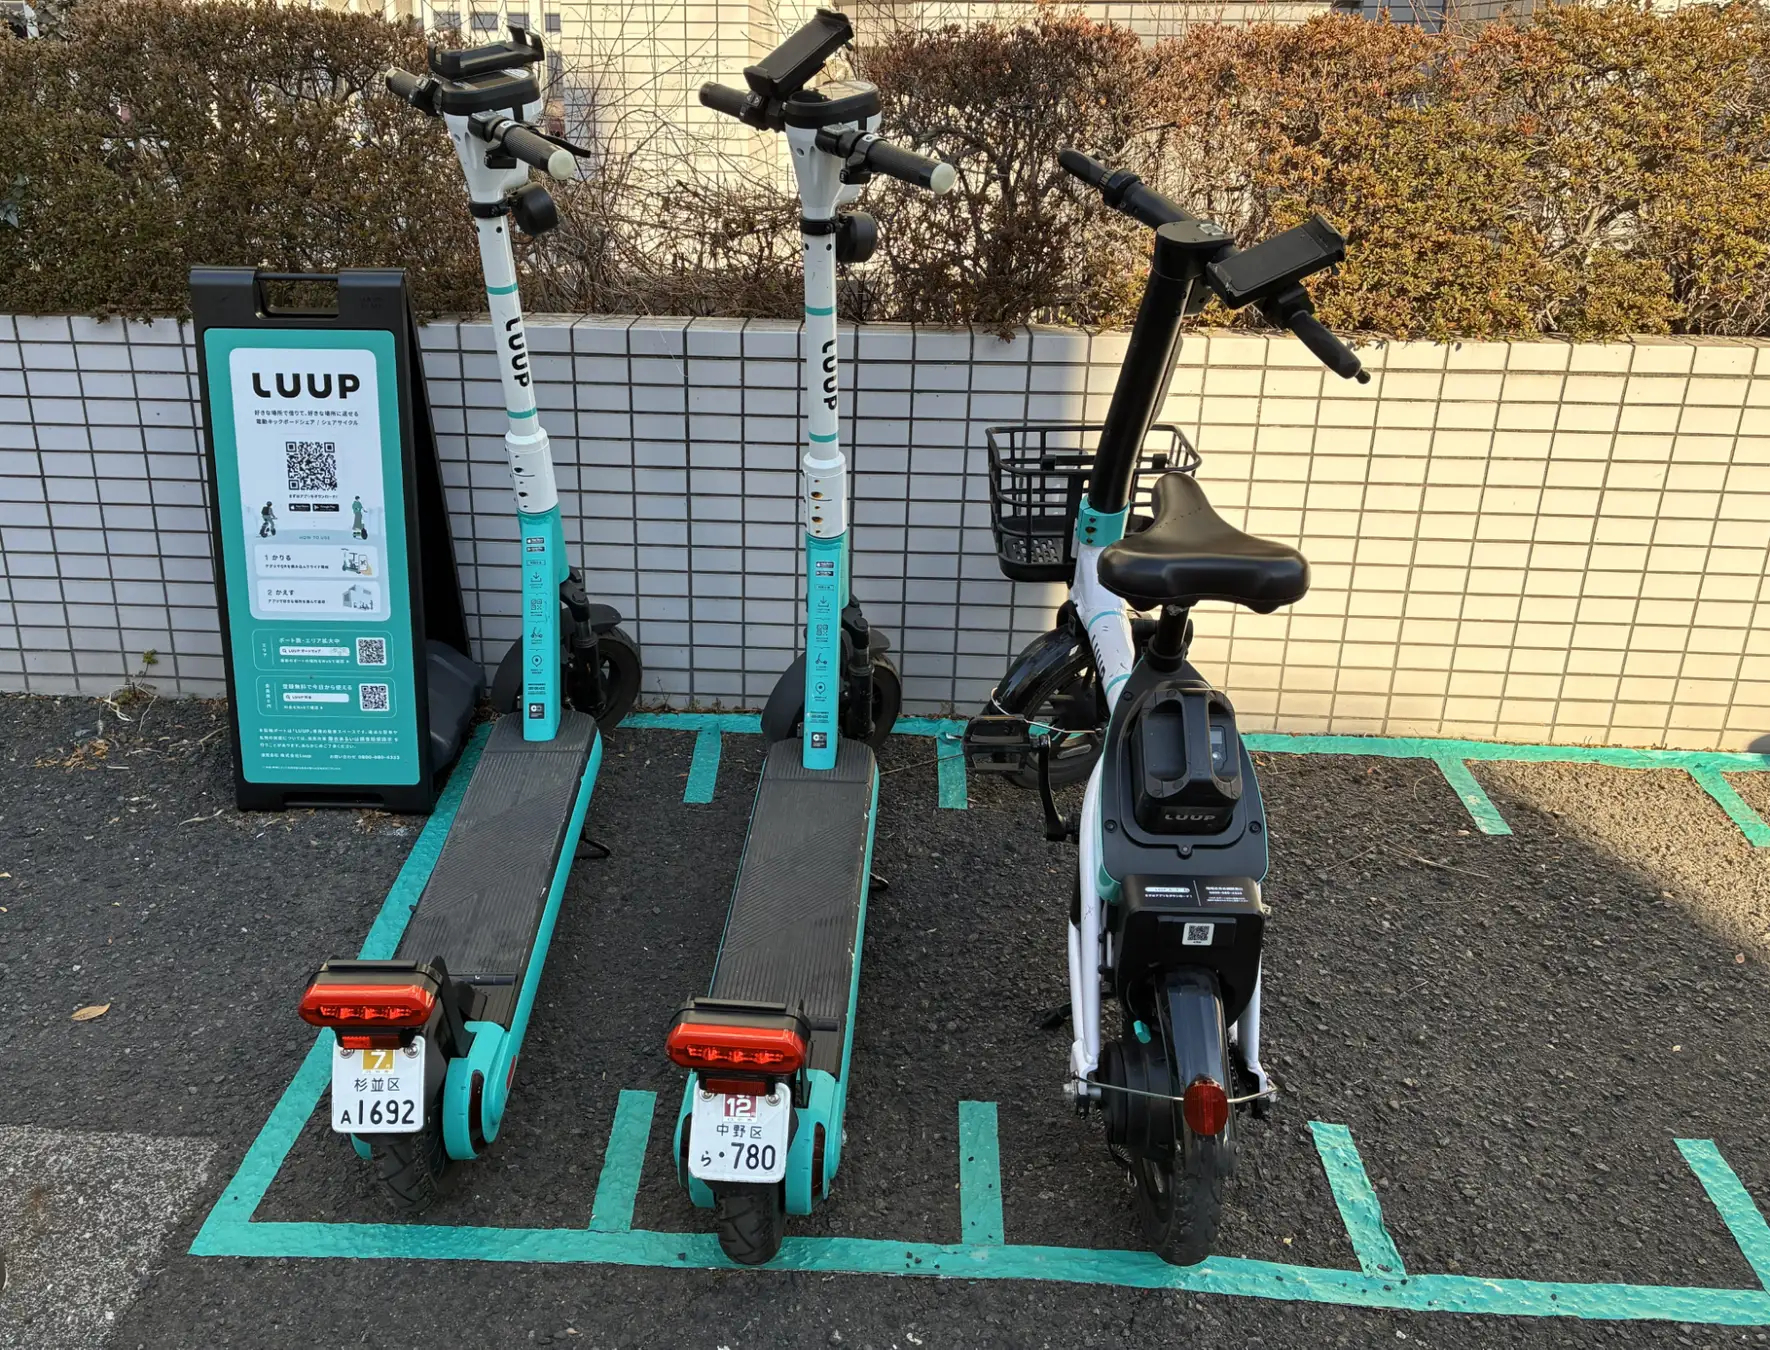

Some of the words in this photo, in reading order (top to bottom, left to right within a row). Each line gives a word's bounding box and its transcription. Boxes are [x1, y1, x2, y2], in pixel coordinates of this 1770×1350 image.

[505, 316, 530, 388] LUUP
[822, 338, 837, 411] LUUP
[251, 372, 361, 399] LUUP
[282, 683, 353, 691] 登録無料で今日から使える
[370, 1051, 387, 1069] 7
[353, 1077, 400, 1093] 杉並区
[726, 1097, 752, 1117] 12
[716, 1123, 763, 1140] 中野区
